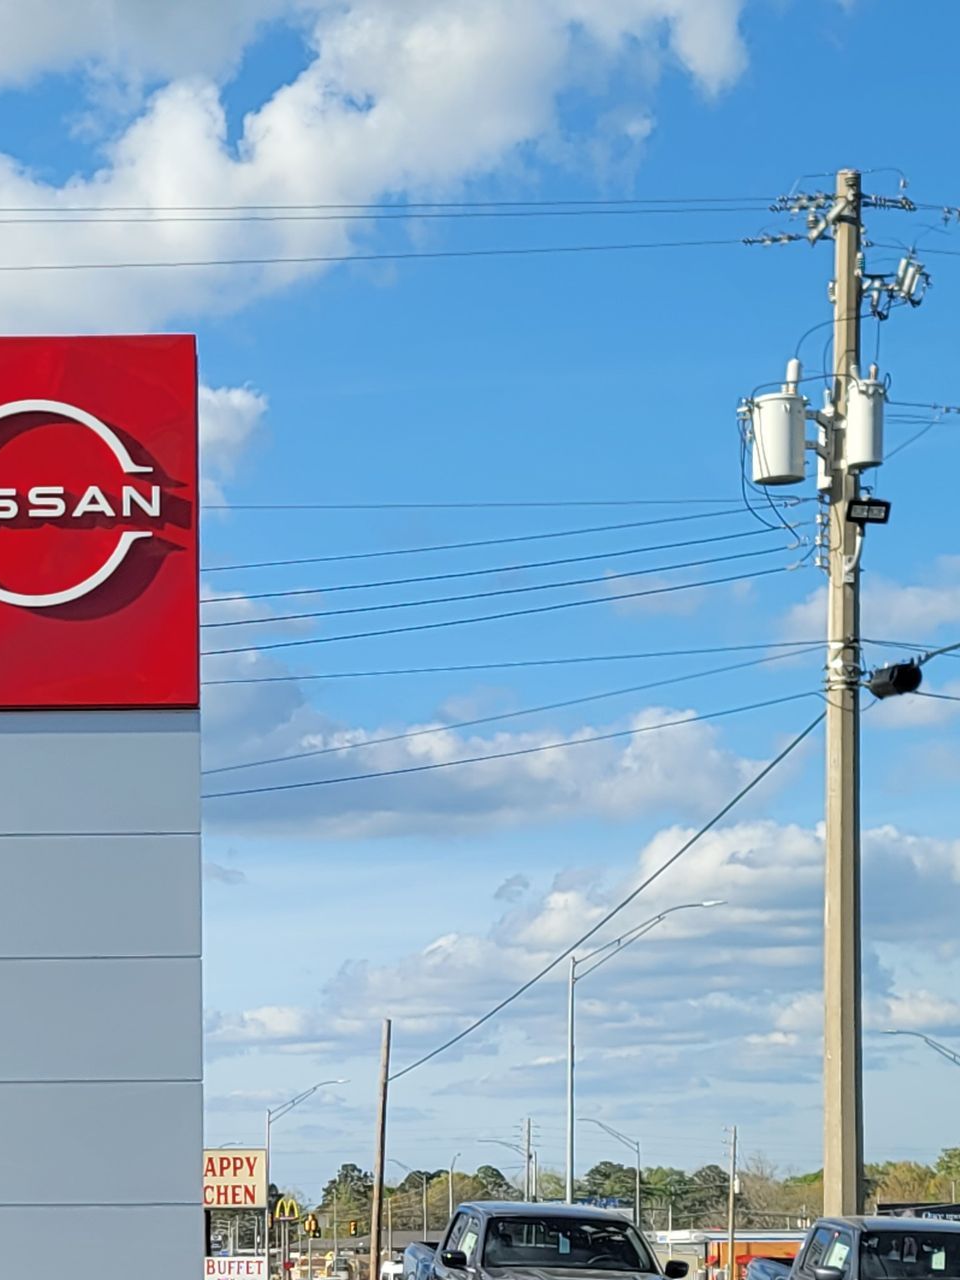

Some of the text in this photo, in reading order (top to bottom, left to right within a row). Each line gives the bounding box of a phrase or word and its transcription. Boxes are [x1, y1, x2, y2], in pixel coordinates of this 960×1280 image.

[203, 1156, 258, 1177] APPY
[203, 1184, 257, 1205] CHEN
[206, 1259, 263, 1275] BUFFET
